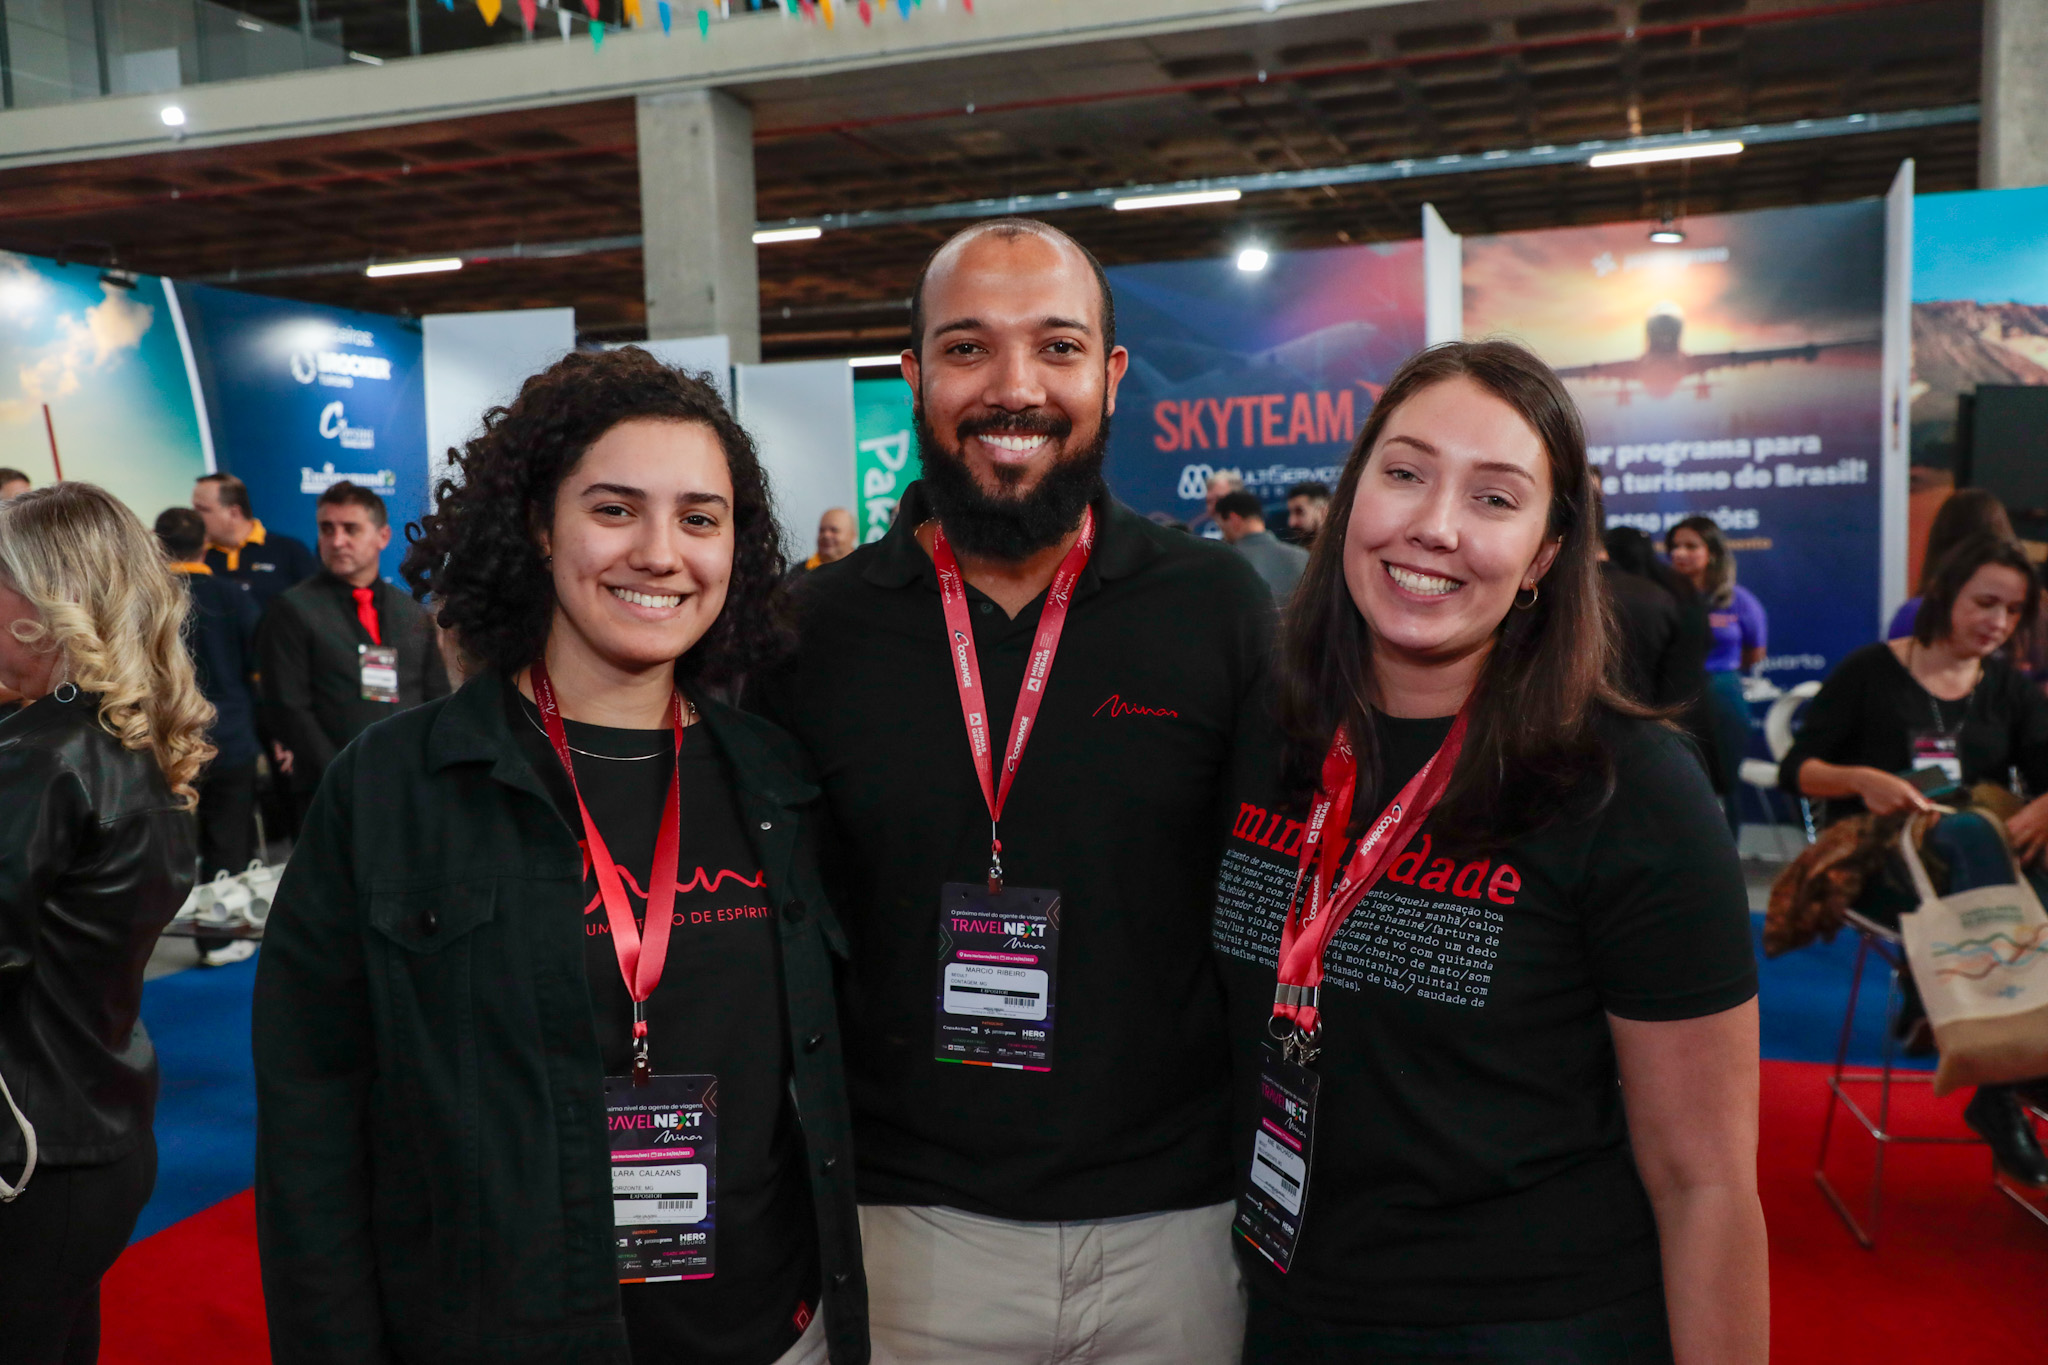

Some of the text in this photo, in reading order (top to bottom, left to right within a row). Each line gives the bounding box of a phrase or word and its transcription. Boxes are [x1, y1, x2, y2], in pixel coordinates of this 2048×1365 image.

[1154, 389, 1354, 452] SKYTEAM
[1616, 438, 1750, 470] programa
[1754, 434, 1822, 462] para
[1602, 458, 1868, 495] e turismo do Brasil!
[939, 568, 952, 604] Minas
[1056, 574, 1076, 608] Minas
[957, 644, 972, 688] CODEMGE
[1031, 651, 1042, 676] MINAS
[1038, 650, 1050, 678] GERAIS
[1092, 694, 1178, 718] Minas
[972, 728, 982, 756] GERAIS
[978, 726, 987, 752] MINAS
[1012, 716, 1030, 760] CODEMGE
[1311, 803, 1323, 830] MINAS
[1316, 802, 1330, 830] GERAIS
[1359, 815, 1393, 857] CODEMGE
[1241, 866, 1264, 878] tomar
[1264, 874, 1284, 886] café
[1372, 901, 1394, 912] logo
[1396, 906, 1422, 918] pela
[1425, 912, 1504, 934] manhã/calor
[1242, 878, 1264, 890] lenha
[1266, 888, 1284, 898] com
[1354, 908, 1376, 920] pela
[1379, 914, 1480, 942] chaminé/fartura
[1485, 936, 1500, 946] de
[1432, 902, 1481, 916] sensação
[1484, 910, 1504, 922] boa
[586, 923, 612, 936] UM
[691, 911, 712, 924] DE
[950, 918, 1046, 938] TRAVELNEXT
[1231, 898, 1253, 910] redor
[1254, 906, 1266, 916] da
[1269, 912, 1287, 922] mes
[1375, 936, 1388, 946] de
[1393, 941, 1407, 951] vó
[1410, 947, 1433, 958] com
[1438, 953, 1494, 970] quitanda
[1003, 937, 1046, 950] Minas
[1248, 916, 1279, 932] violão
[1410, 959, 1425, 970] de
[1430, 964, 1490, 983] mato/som
[1350, 919, 1380, 932] gente
[1384, 926, 1440, 946] trocando
[1445, 941, 1462, 952] um
[1467, 945, 1498, 958] dedo
[1231, 948, 1256, 962] define
[1246, 928, 1258, 938] do
[1332, 950, 1342, 960] da
[1346, 956, 1460, 992] montanha/quintal
[1465, 985, 1488, 996] com
[966, 966, 1026, 978] MARCIO RIBEIRO
[1252, 943, 1280, 958] memór
[1332, 964, 1364, 979] danado
[1367, 973, 1380, 984] de
[1384, 976, 1414, 994] bão/
[1417, 989, 1466, 1004] saudade
[1471, 998, 1485, 1008] de
[1022, 1030, 1046, 1038] HERO
[608, 1110, 703, 1130] RAVELNEXT
[654, 1130, 702, 1144] Minas
[680, 1232, 706, 1241] HERO
